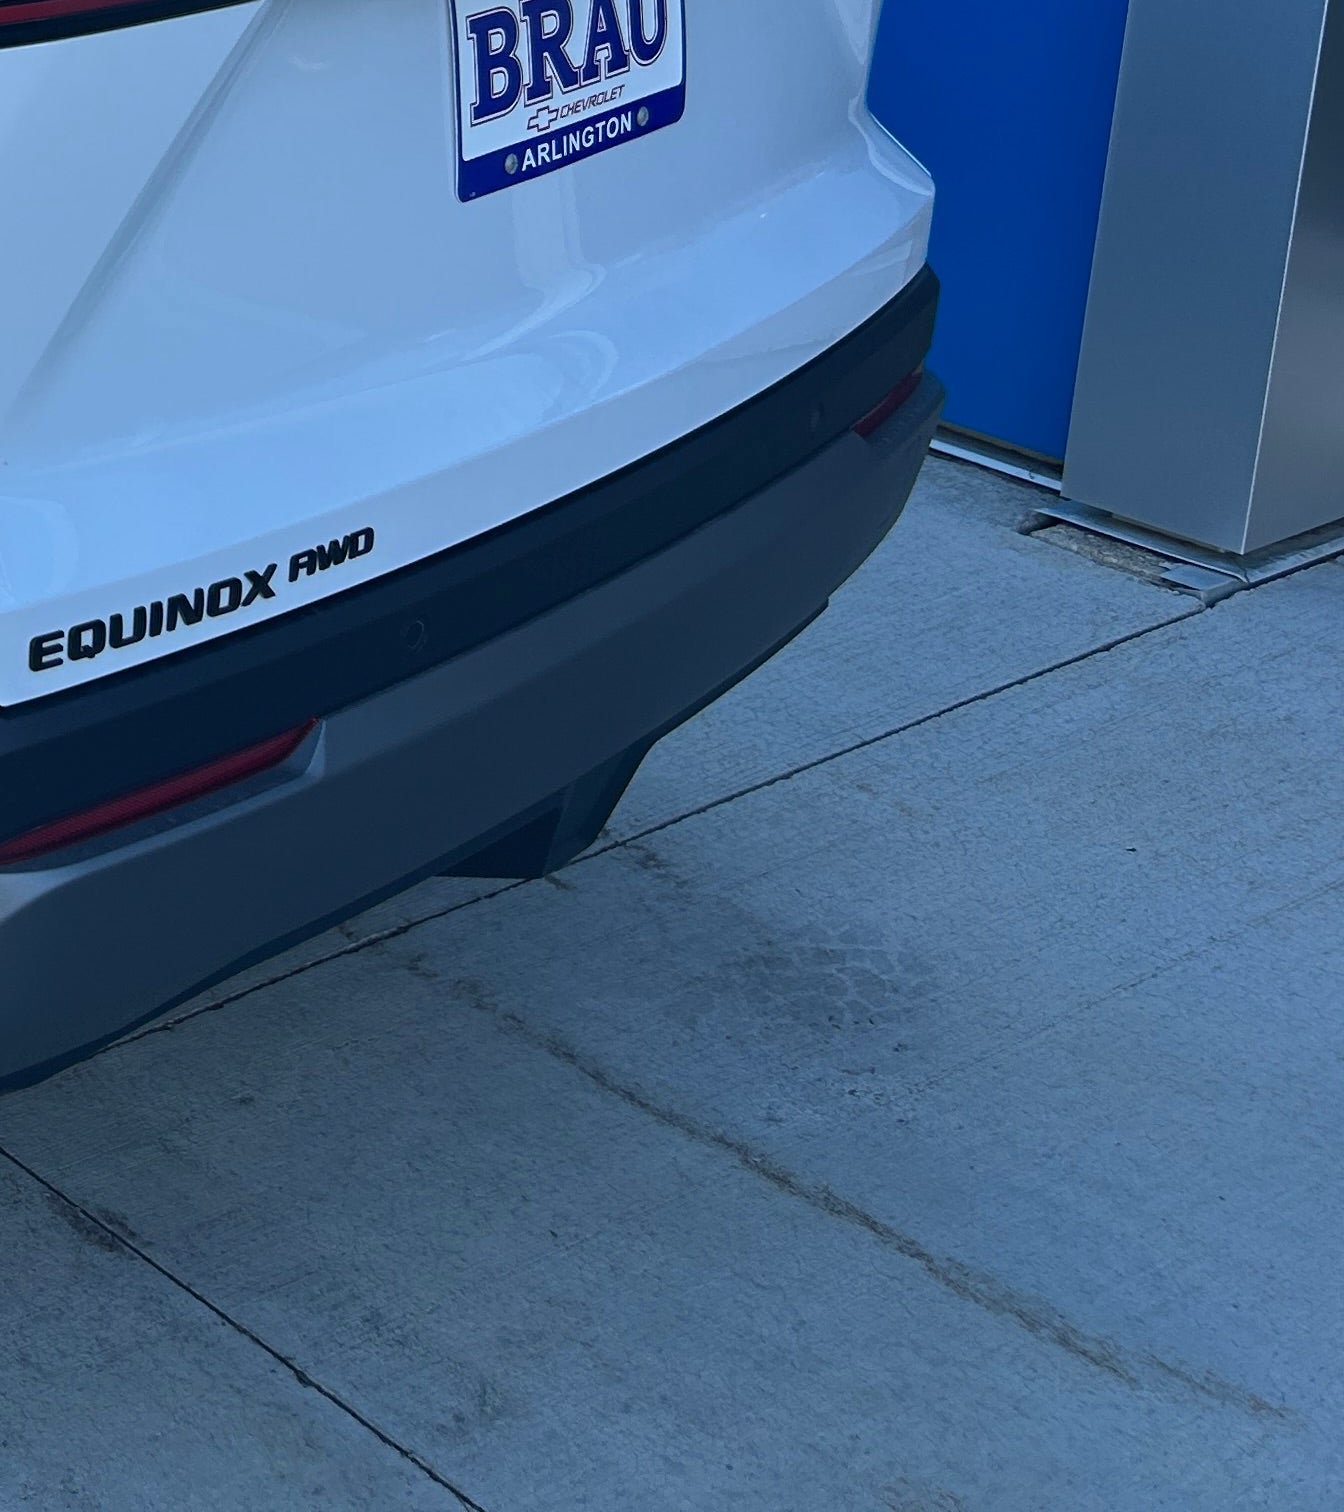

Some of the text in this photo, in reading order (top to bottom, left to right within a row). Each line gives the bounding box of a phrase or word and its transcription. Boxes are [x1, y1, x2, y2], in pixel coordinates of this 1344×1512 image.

[559, 84, 626, 118] CHEVROLET
[521, 111, 633, 171] ARLINGTON
[28, 526, 375, 672] EQUINOX AWD
